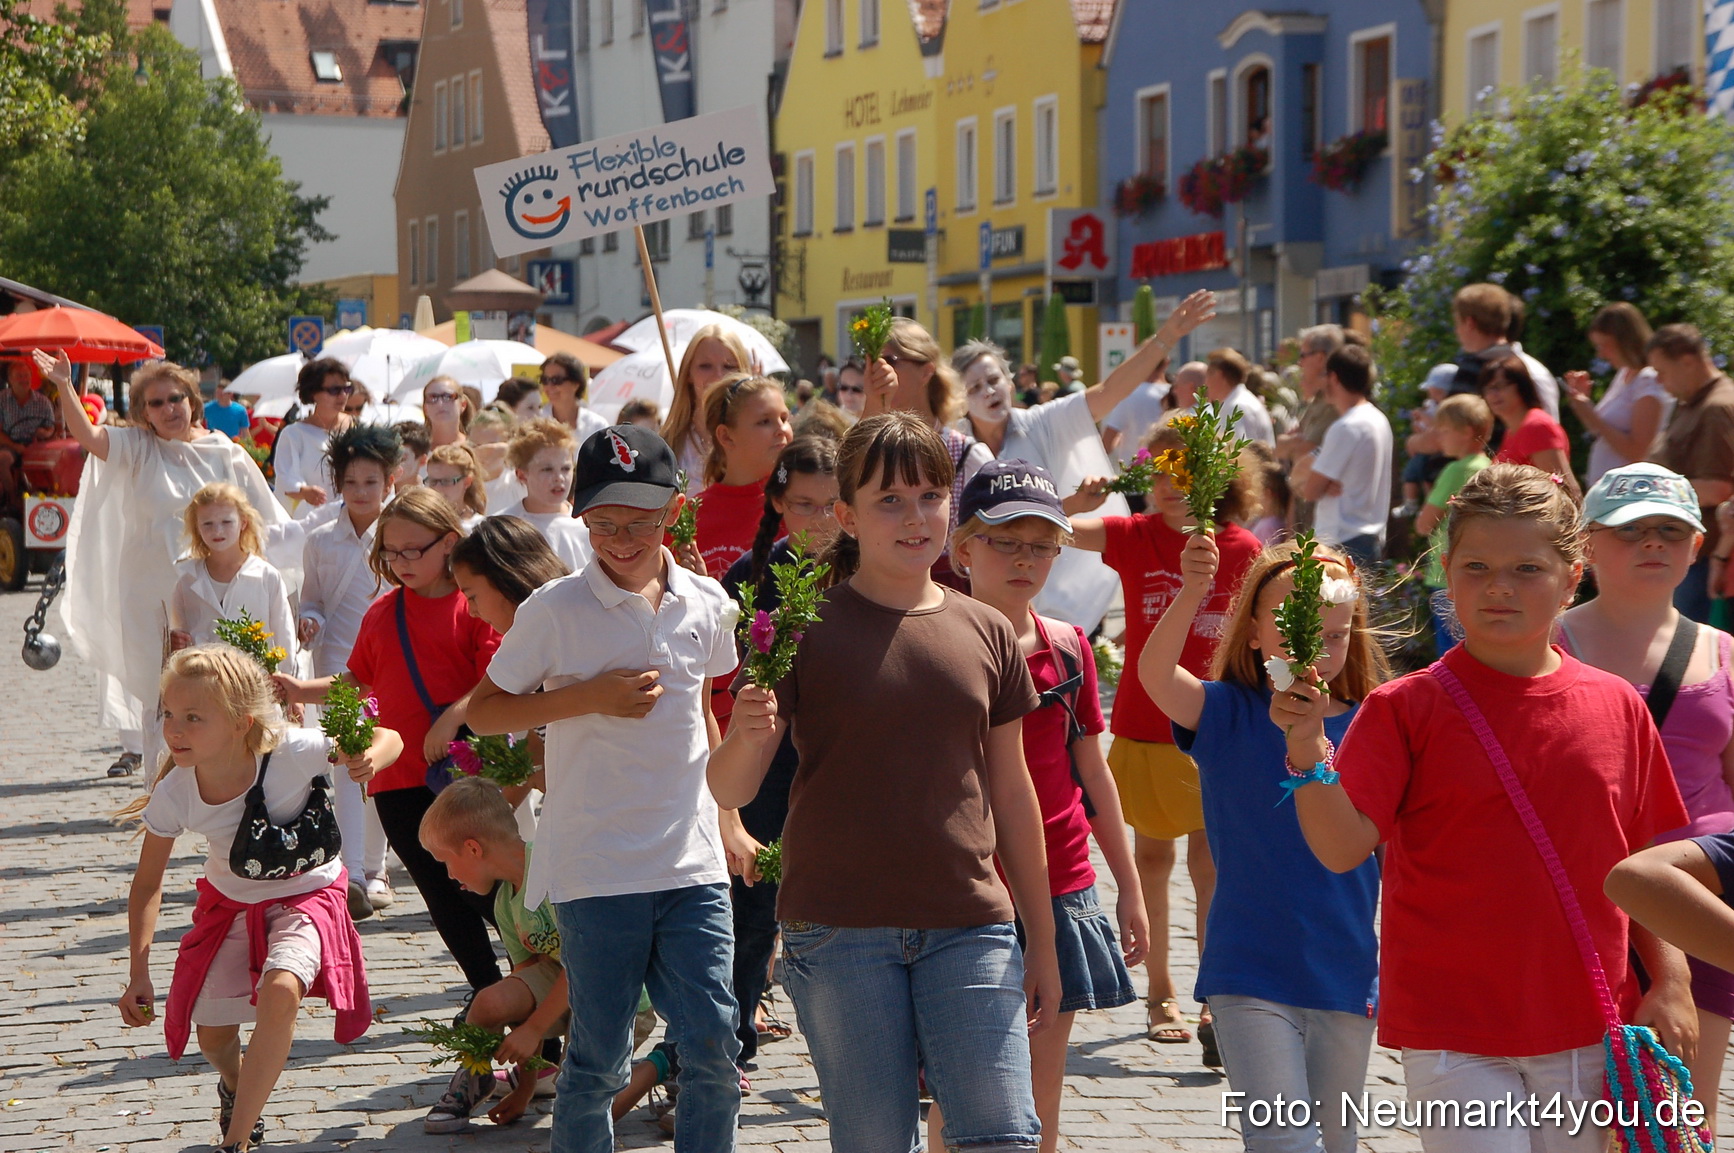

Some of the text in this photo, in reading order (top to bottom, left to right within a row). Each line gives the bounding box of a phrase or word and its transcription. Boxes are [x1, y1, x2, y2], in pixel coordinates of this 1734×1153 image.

[844, 92, 882, 128] HOTEL
[566, 135, 677, 179] Flexible
[577, 141, 746, 202] rundschule
[584, 175, 745, 227] Woffenbach
